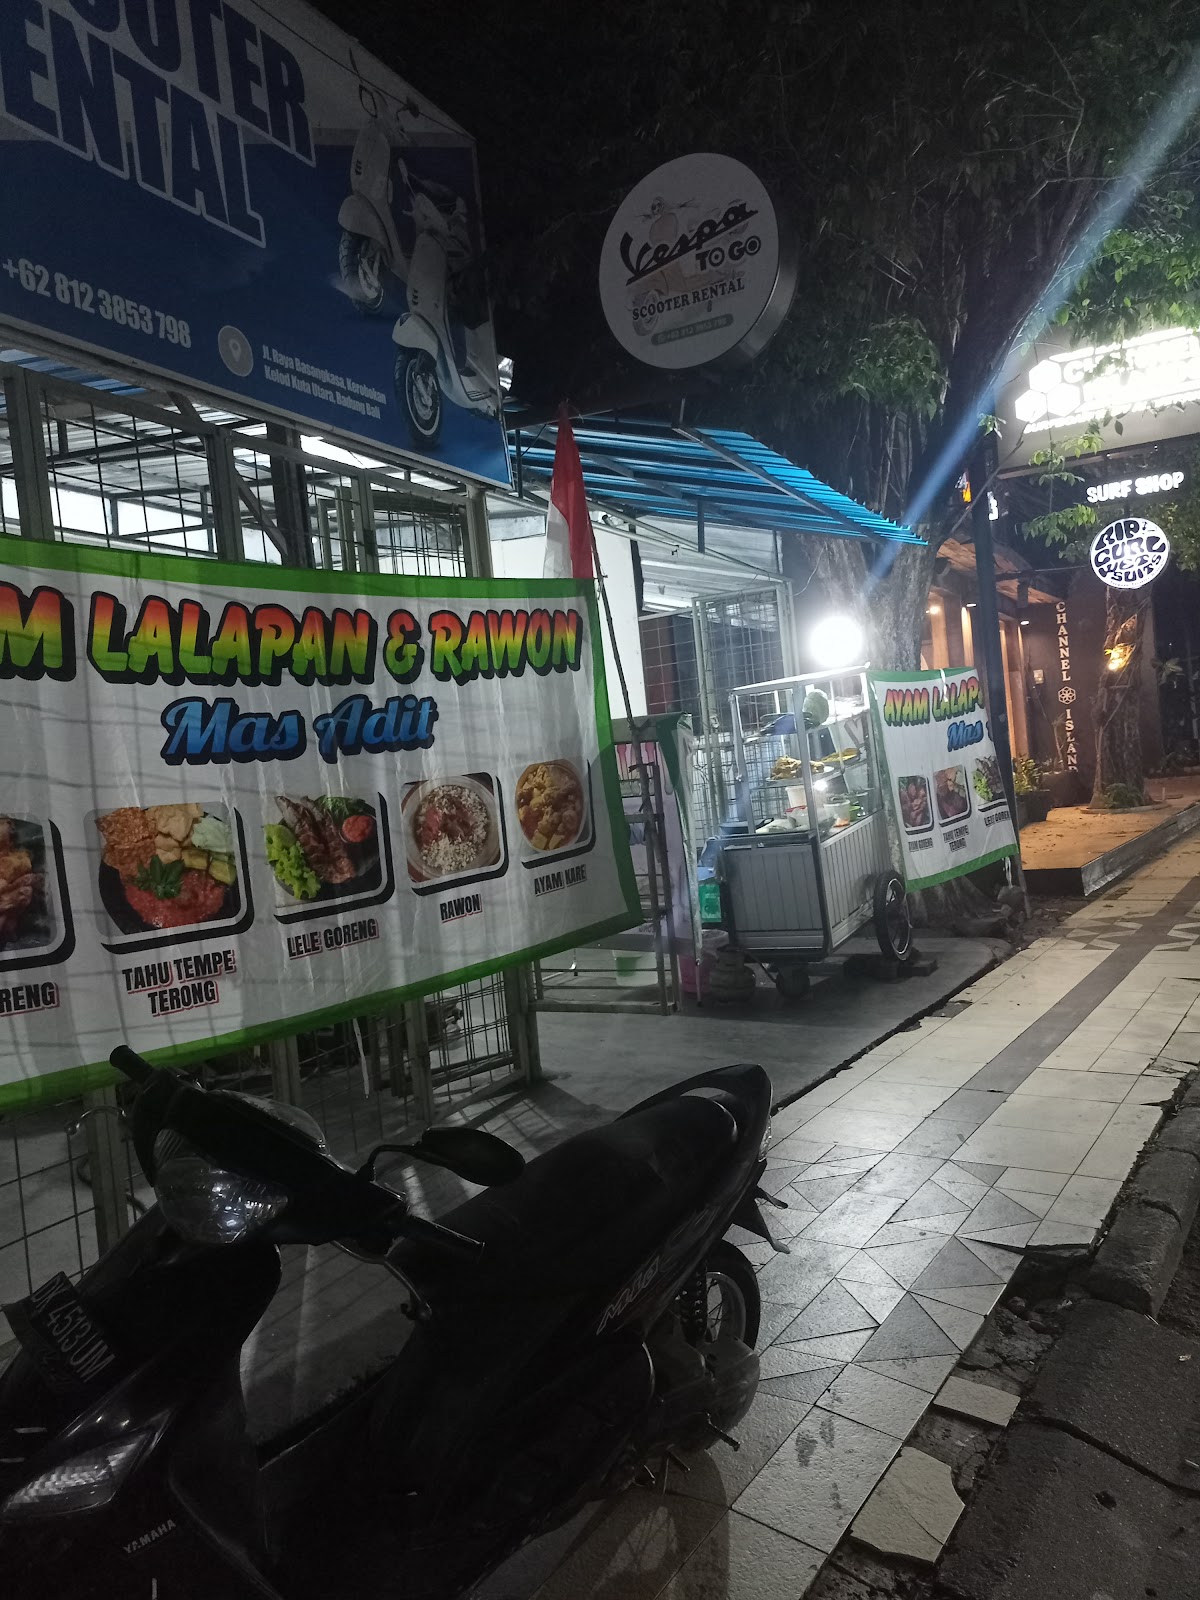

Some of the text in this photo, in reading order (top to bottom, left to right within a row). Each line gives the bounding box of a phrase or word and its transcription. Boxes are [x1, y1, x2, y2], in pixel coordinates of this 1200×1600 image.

[68, 0, 316, 168] OTER
[620, 203, 759, 286] Vespa
[696, 235, 762, 272] TO GO
[2, 258, 192, 349] +62 812 3853 798
[632, 278, 745, 321] SCOOTER RENTAL
[264, 364, 291, 387] Kelod
[291, 374, 311, 395] Kuta
[336, 391, 366, 416] Badung
[366, 402, 381, 419] Bali
[272, 348, 295, 370] Raya
[346, 377, 387, 405] Kerobokan
[1086, 471, 1185, 503] SURF SHOP
[1094, 536, 1166, 567] CURL
[1095, 520, 1140, 551] RIP
[87, 591, 378, 686] LALAPAN
[383, 609, 425, 684] &
[428, 608, 583, 686] RAWON
[1055, 601, 1071, 682] CHANNEL
[883, 688, 930, 727] AYAM
[160, 694, 439, 765] Mas Adit
[947, 720, 984, 752] Mas
[533, 864, 587, 897] AYAM KARE
[439, 893, 483, 924] RAWON
[286, 918, 379, 960] LELE GORENG
[121, 949, 237, 994] TAHU TEMPE
[147, 980, 219, 1017] TERONG
[30, 1277, 70, 1313] DK
[47, 1300, 92, 1352] 4513
[70, 1332, 116, 1383] UM
[122, 1518, 177, 1555] YAMAHA
